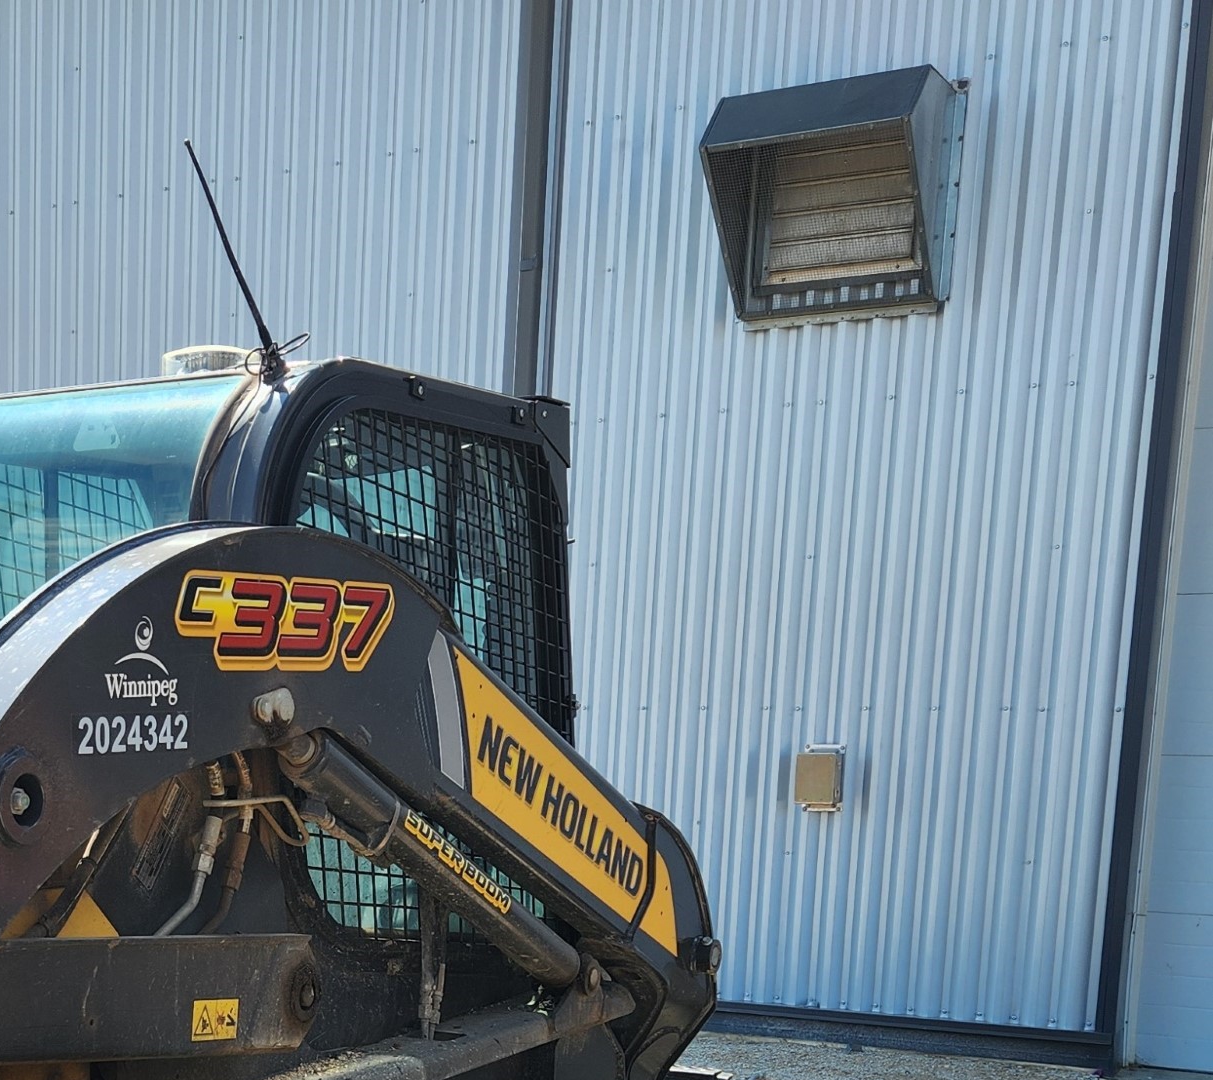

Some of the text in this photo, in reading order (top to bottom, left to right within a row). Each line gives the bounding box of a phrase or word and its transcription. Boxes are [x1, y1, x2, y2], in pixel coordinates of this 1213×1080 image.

[105, 673, 178, 706] Winnipeg
[78, 714, 188, 755] 2024342
[477, 714, 644, 897] NEW HOLLAND
